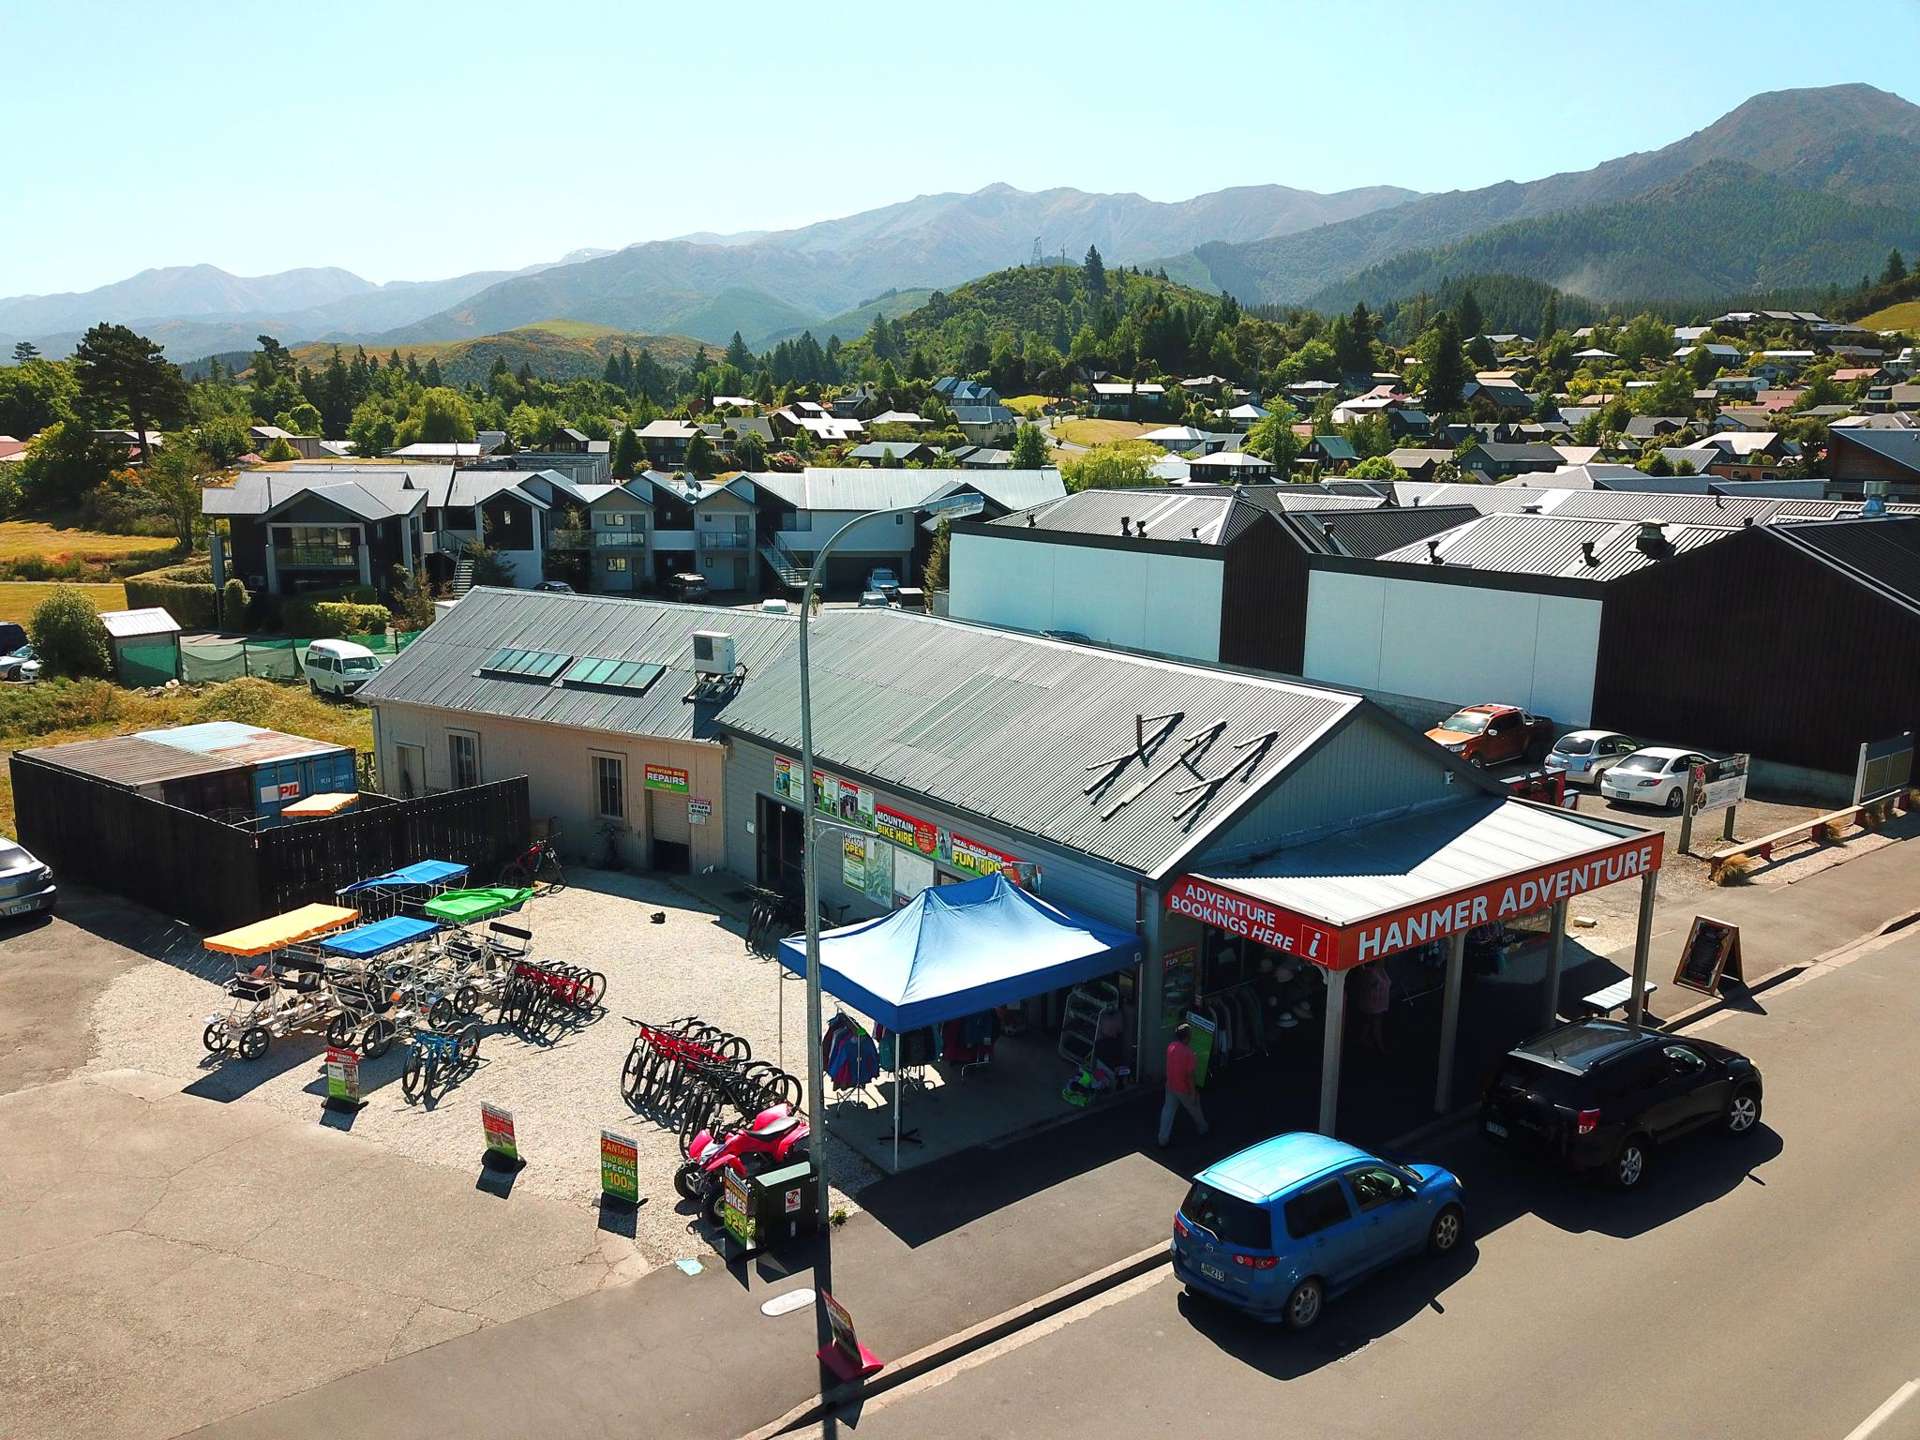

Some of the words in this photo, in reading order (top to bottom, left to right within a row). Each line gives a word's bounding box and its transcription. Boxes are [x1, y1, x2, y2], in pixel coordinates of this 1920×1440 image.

[647, 772, 685, 786] REPAIRS
[279, 783, 300, 797] PIL
[876, 811, 914, 832] MOUNTAIN
[877, 823, 894, 839] BIKE
[895, 829, 913, 847] HIRE
[845, 842, 865, 858] OPEN
[953, 850, 974, 869] FUN
[969, 844, 986, 856] QUAD
[1185, 884, 1276, 928] ADVENTURE
[1358, 895, 1488, 961] HANMER
[1497, 846, 1653, 917] ADVENTURE
[1171, 895, 1248, 935] BOOKINGS
[1251, 925, 1294, 951] HERE
[1308, 932, 1321, 957] i
[602, 1160, 637, 1178] SPECIAL
[617, 1157, 636, 1170] BIKE
[724, 1187, 747, 1215] BIKES
